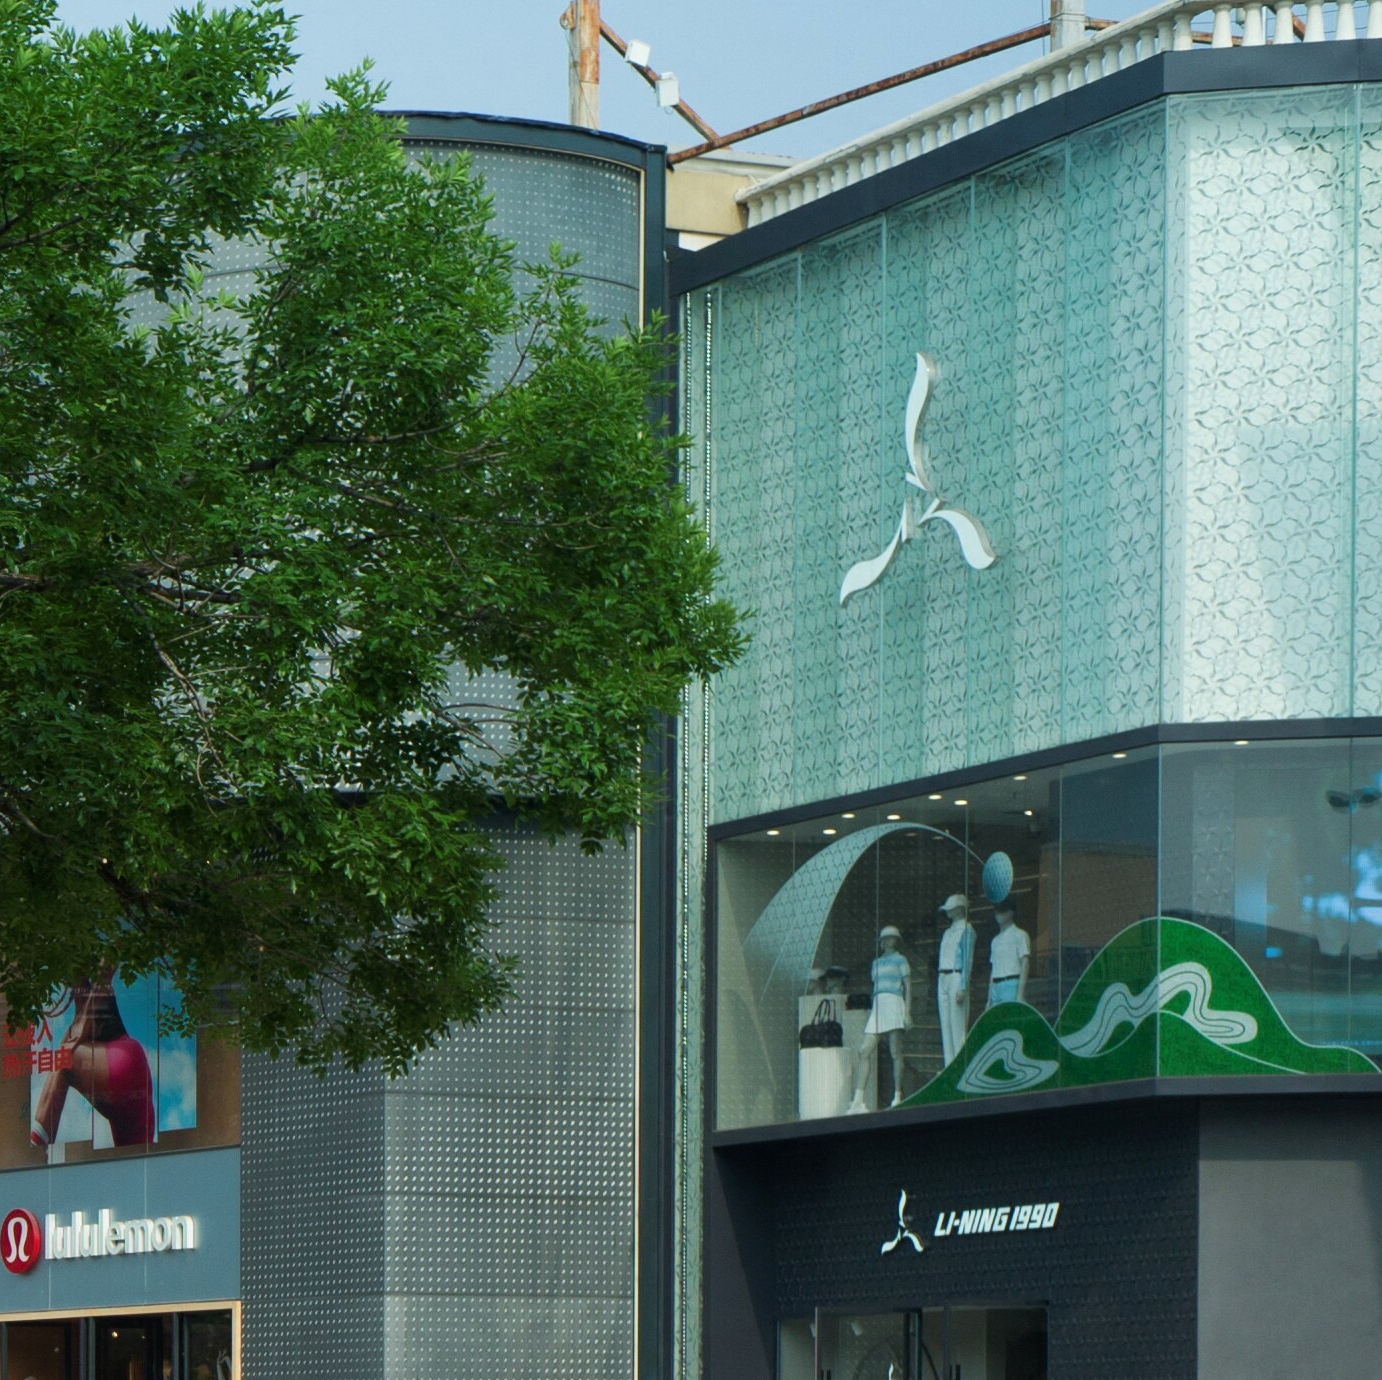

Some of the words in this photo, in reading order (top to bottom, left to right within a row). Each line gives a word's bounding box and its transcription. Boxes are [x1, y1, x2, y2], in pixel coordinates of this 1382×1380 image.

[45, 1208, 195, 1260] lululemon
[934, 1206, 1011, 1237] LI-NING
[1009, 1202, 1060, 1231] 1990
